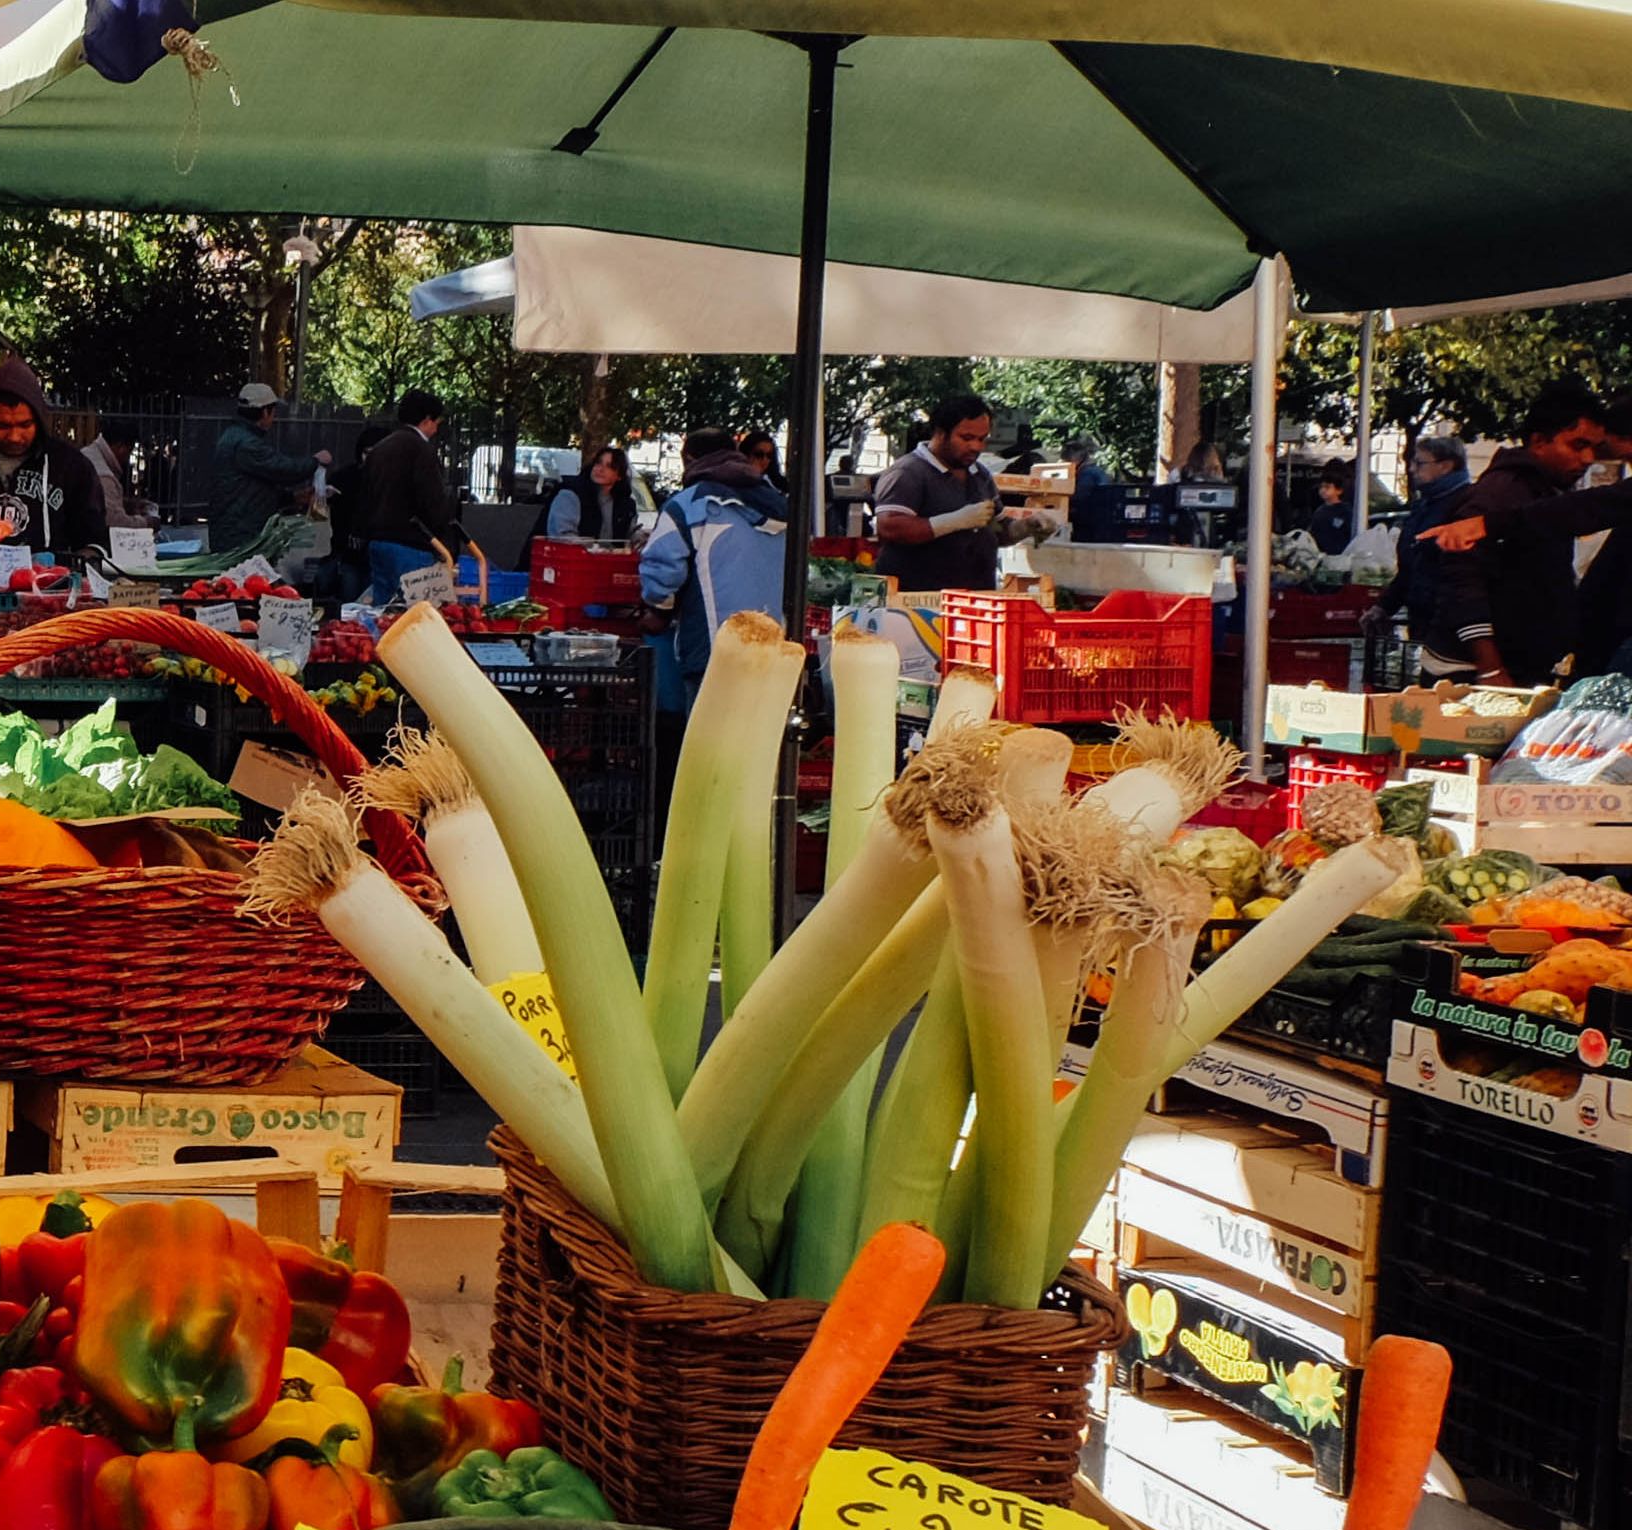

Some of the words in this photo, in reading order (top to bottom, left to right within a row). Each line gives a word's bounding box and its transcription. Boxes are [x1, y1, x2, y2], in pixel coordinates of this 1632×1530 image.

[1532, 793, 1622, 812] TOTO
[1411, 989, 1435, 1017] la
[1436, 1001, 1511, 1035] natura
[1513, 1013, 1538, 1043] in
[83, 1104, 217, 1136] Grande
[260, 1107, 368, 1139] Bosco
[1457, 1078, 1556, 1126] TORELLO
[1179, 1328, 1268, 1384] MONTENEGRO
[1199, 1320, 1250, 1362] FRUTTA
